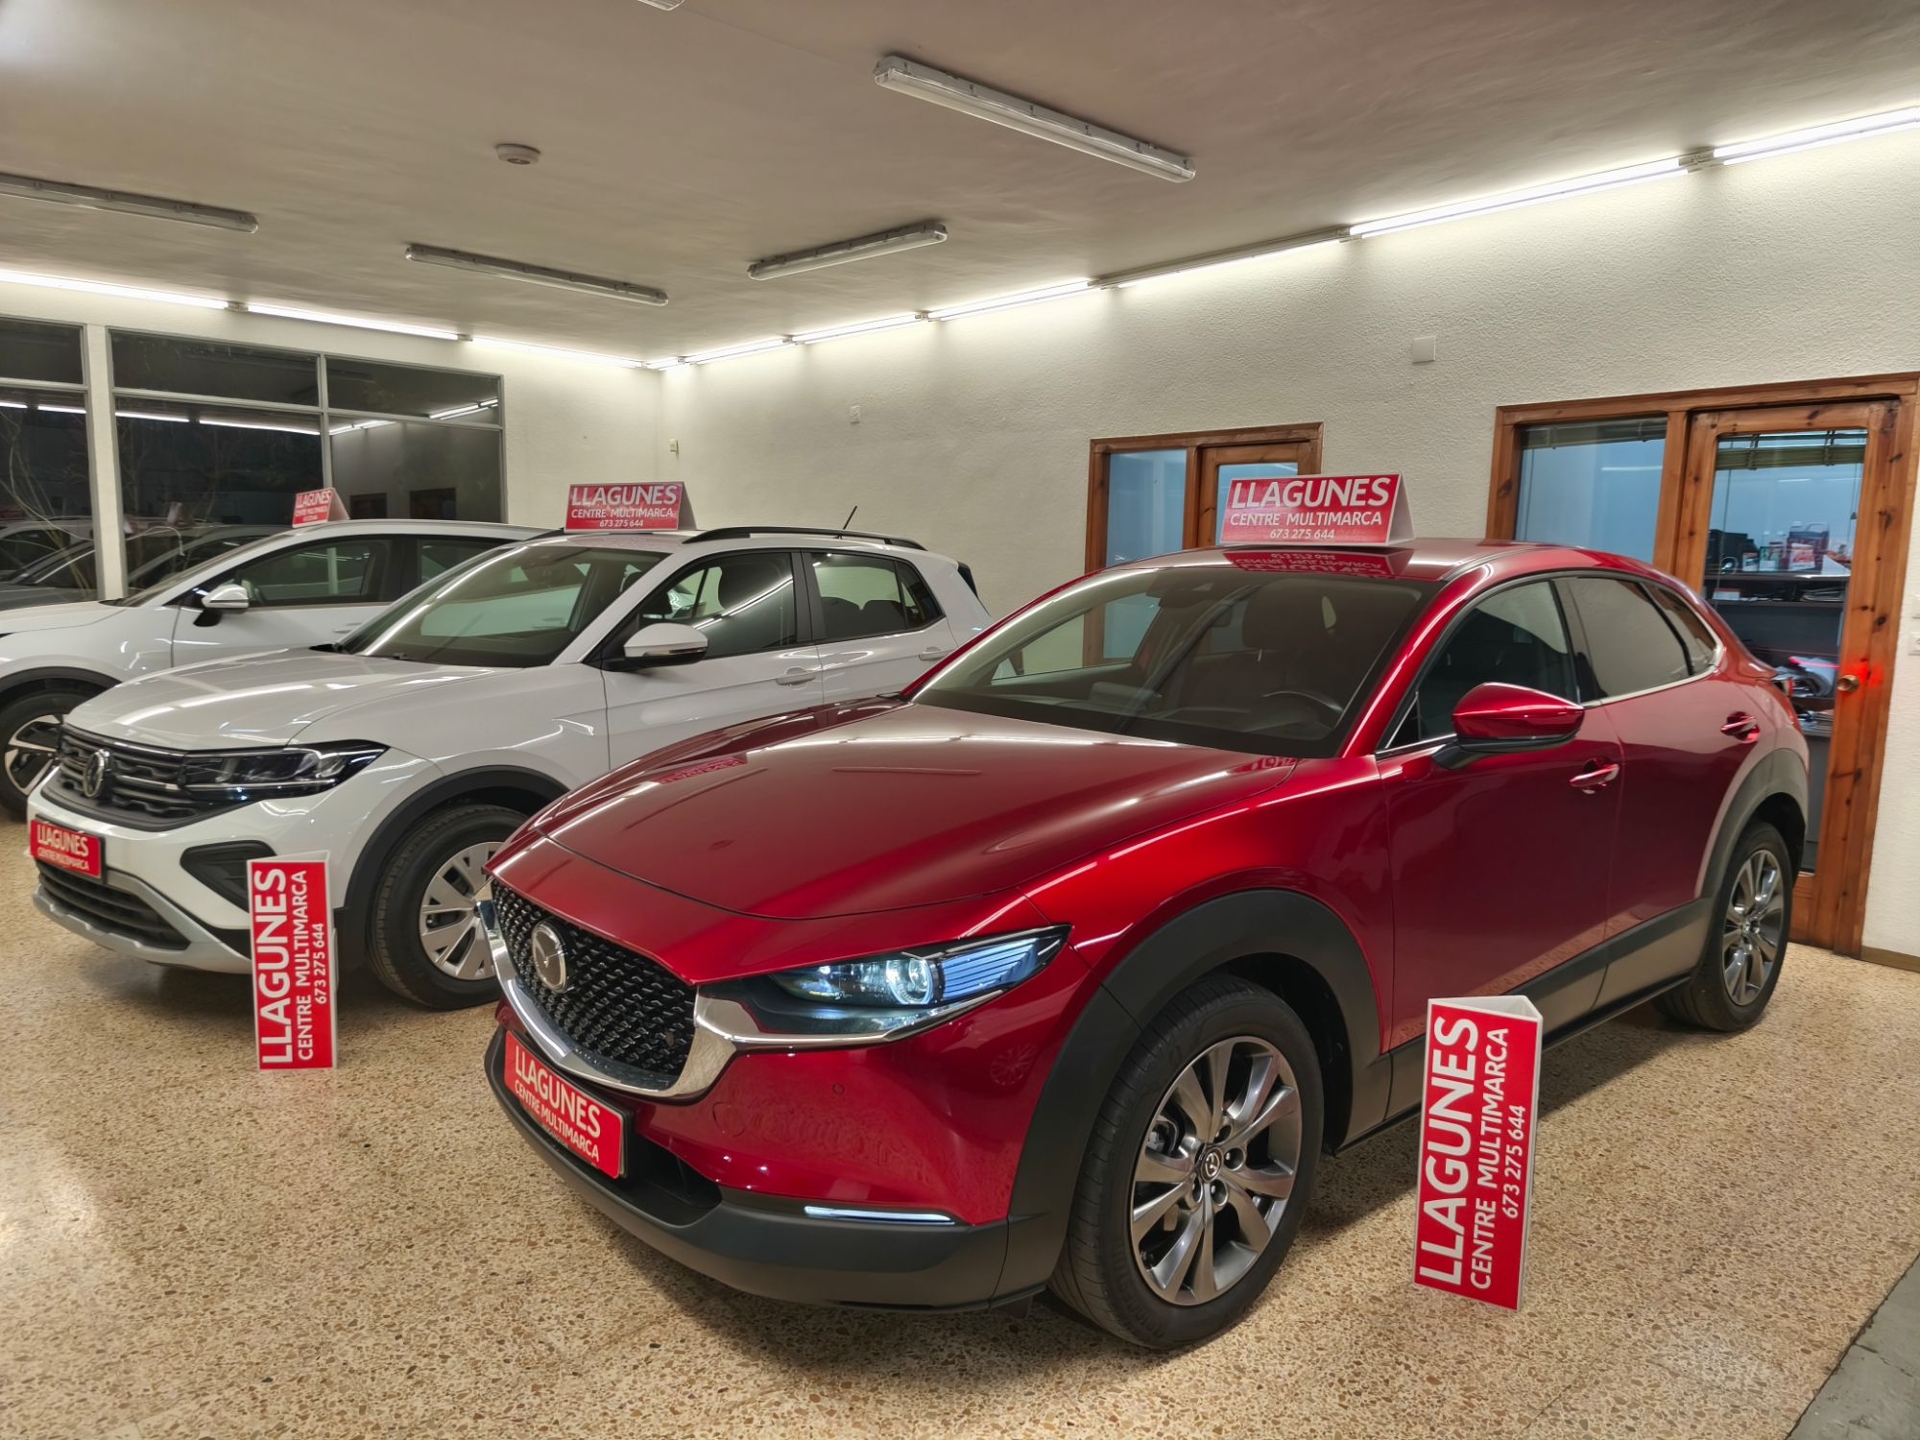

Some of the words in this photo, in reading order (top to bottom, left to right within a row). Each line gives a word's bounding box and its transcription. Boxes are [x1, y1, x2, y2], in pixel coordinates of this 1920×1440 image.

[571, 485, 677, 506] LLAGUNES
[1232, 477, 1390, 509] LLAGUNES
[571, 508, 607, 518] CENTRE
[610, 507, 674, 518] MULTIMARCA
[614, 519, 628, 527] 275
[629, 519, 644, 527] 644
[1230, 513, 1280, 526] CENTRE
[1286, 511, 1382, 526] MULTIMARCA
[1269, 529, 1289, 540] 673
[1292, 529, 1311, 540] 275
[1314, 529, 1335, 540] 644
[37, 824, 89, 857] LLAGUNES
[291, 870, 310, 987] MULTIMARCA
[312, 923, 325, 949] 644
[254, 868, 293, 1063] LLAGUNES
[313, 952, 326, 977] 275
[314, 979, 327, 1005] 673
[296, 995, 314, 1061] CENTRE
[515, 1045, 601, 1139] LLAGUNES
[1477, 1028, 1509, 1189] MULTIMARCA
[514, 1079, 540, 1114] CENTRE
[540, 1104, 600, 1163] MULTIMARCA
[1508, 1105, 1526, 1140] 644
[1419, 1016, 1478, 1286] LLAGUNES
[1505, 1146, 1523, 1180] 275
[1502, 1186, 1520, 1220] 673
[1470, 1197, 1497, 1290] CENTRE
